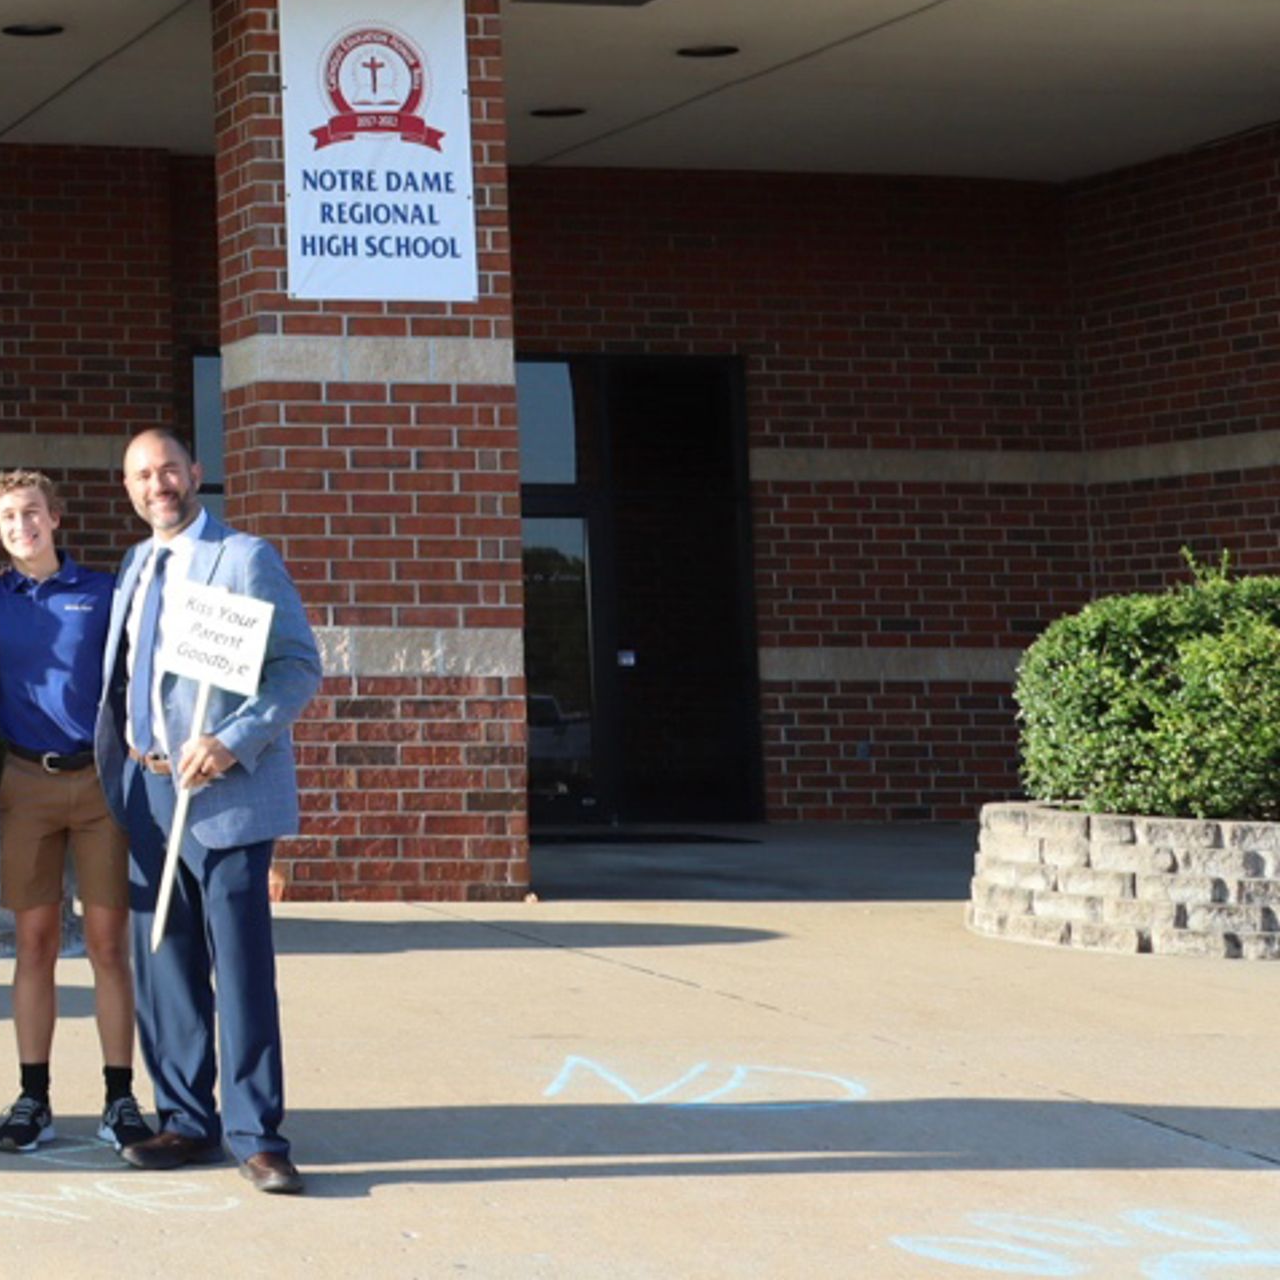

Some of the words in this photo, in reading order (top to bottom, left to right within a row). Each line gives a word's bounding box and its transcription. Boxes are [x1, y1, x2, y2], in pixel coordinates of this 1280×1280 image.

[302, 169, 378, 192] NOTRE
[385, 170, 455, 194] DAME
[320, 201, 440, 226] REGIONAL
[300, 234, 358, 257] HIGH
[364, 235, 462, 259] SCHOOL
[218, 605, 258, 629] Your
